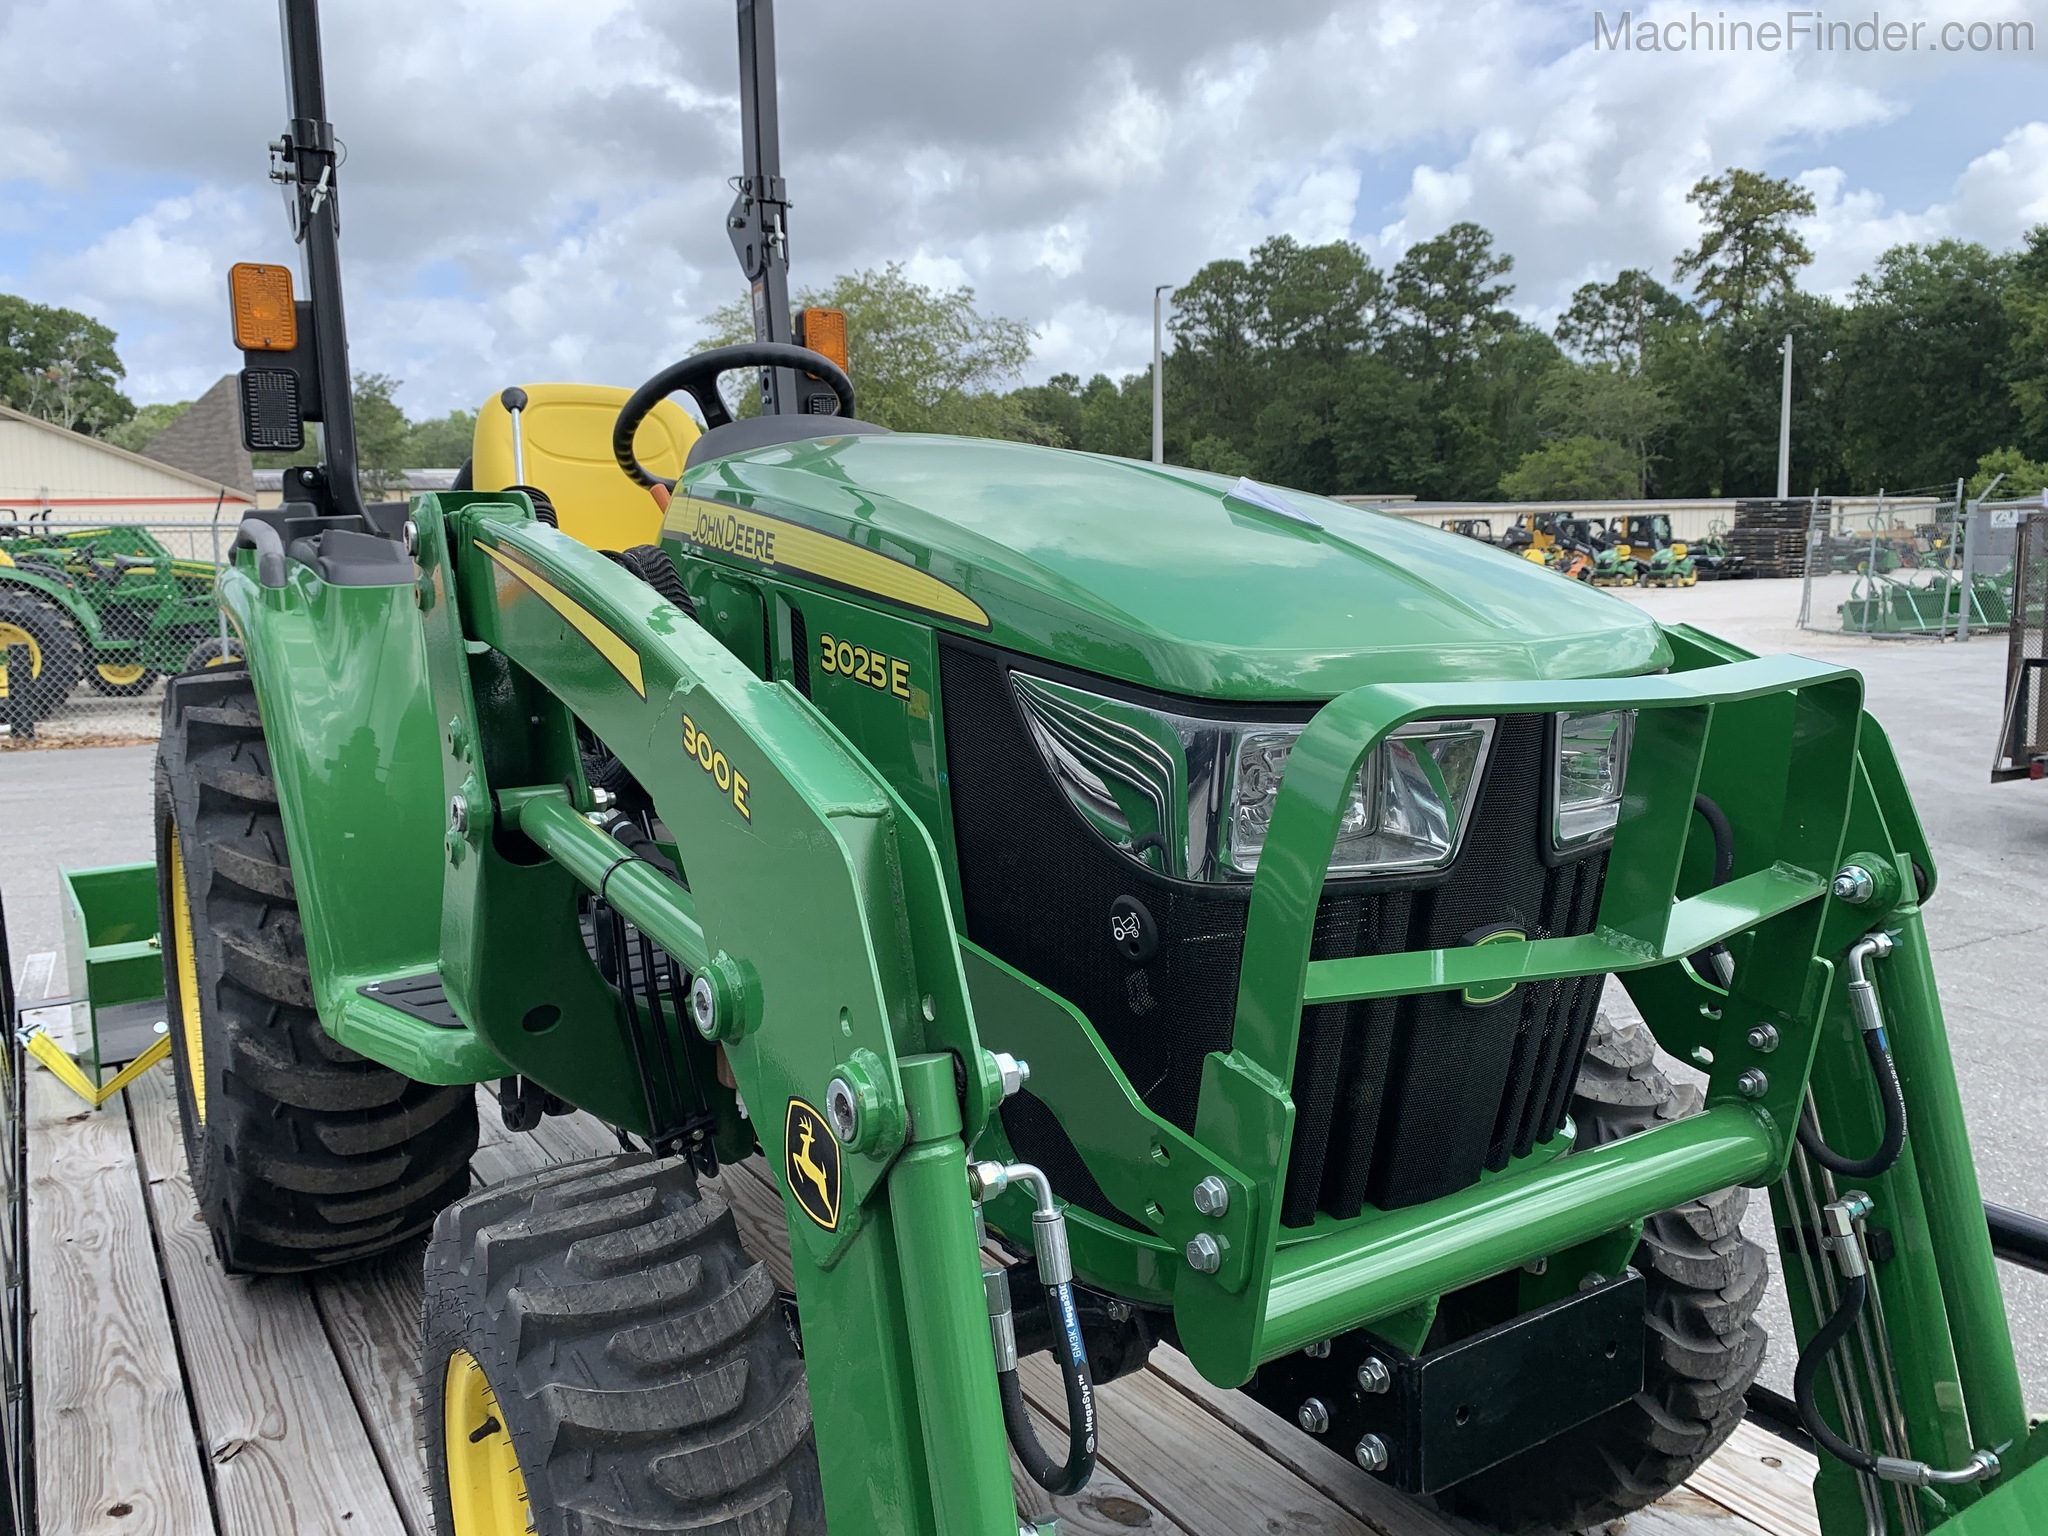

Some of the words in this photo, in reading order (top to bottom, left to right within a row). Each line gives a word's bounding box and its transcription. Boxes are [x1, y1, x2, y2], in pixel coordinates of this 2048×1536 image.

[692, 507, 725, 545] JOHN
[725, 514, 776, 561] DEERE
[1894, 1080, 1904, 1101] MSHA
[1068, 1329, 1082, 1358] 6M3K
